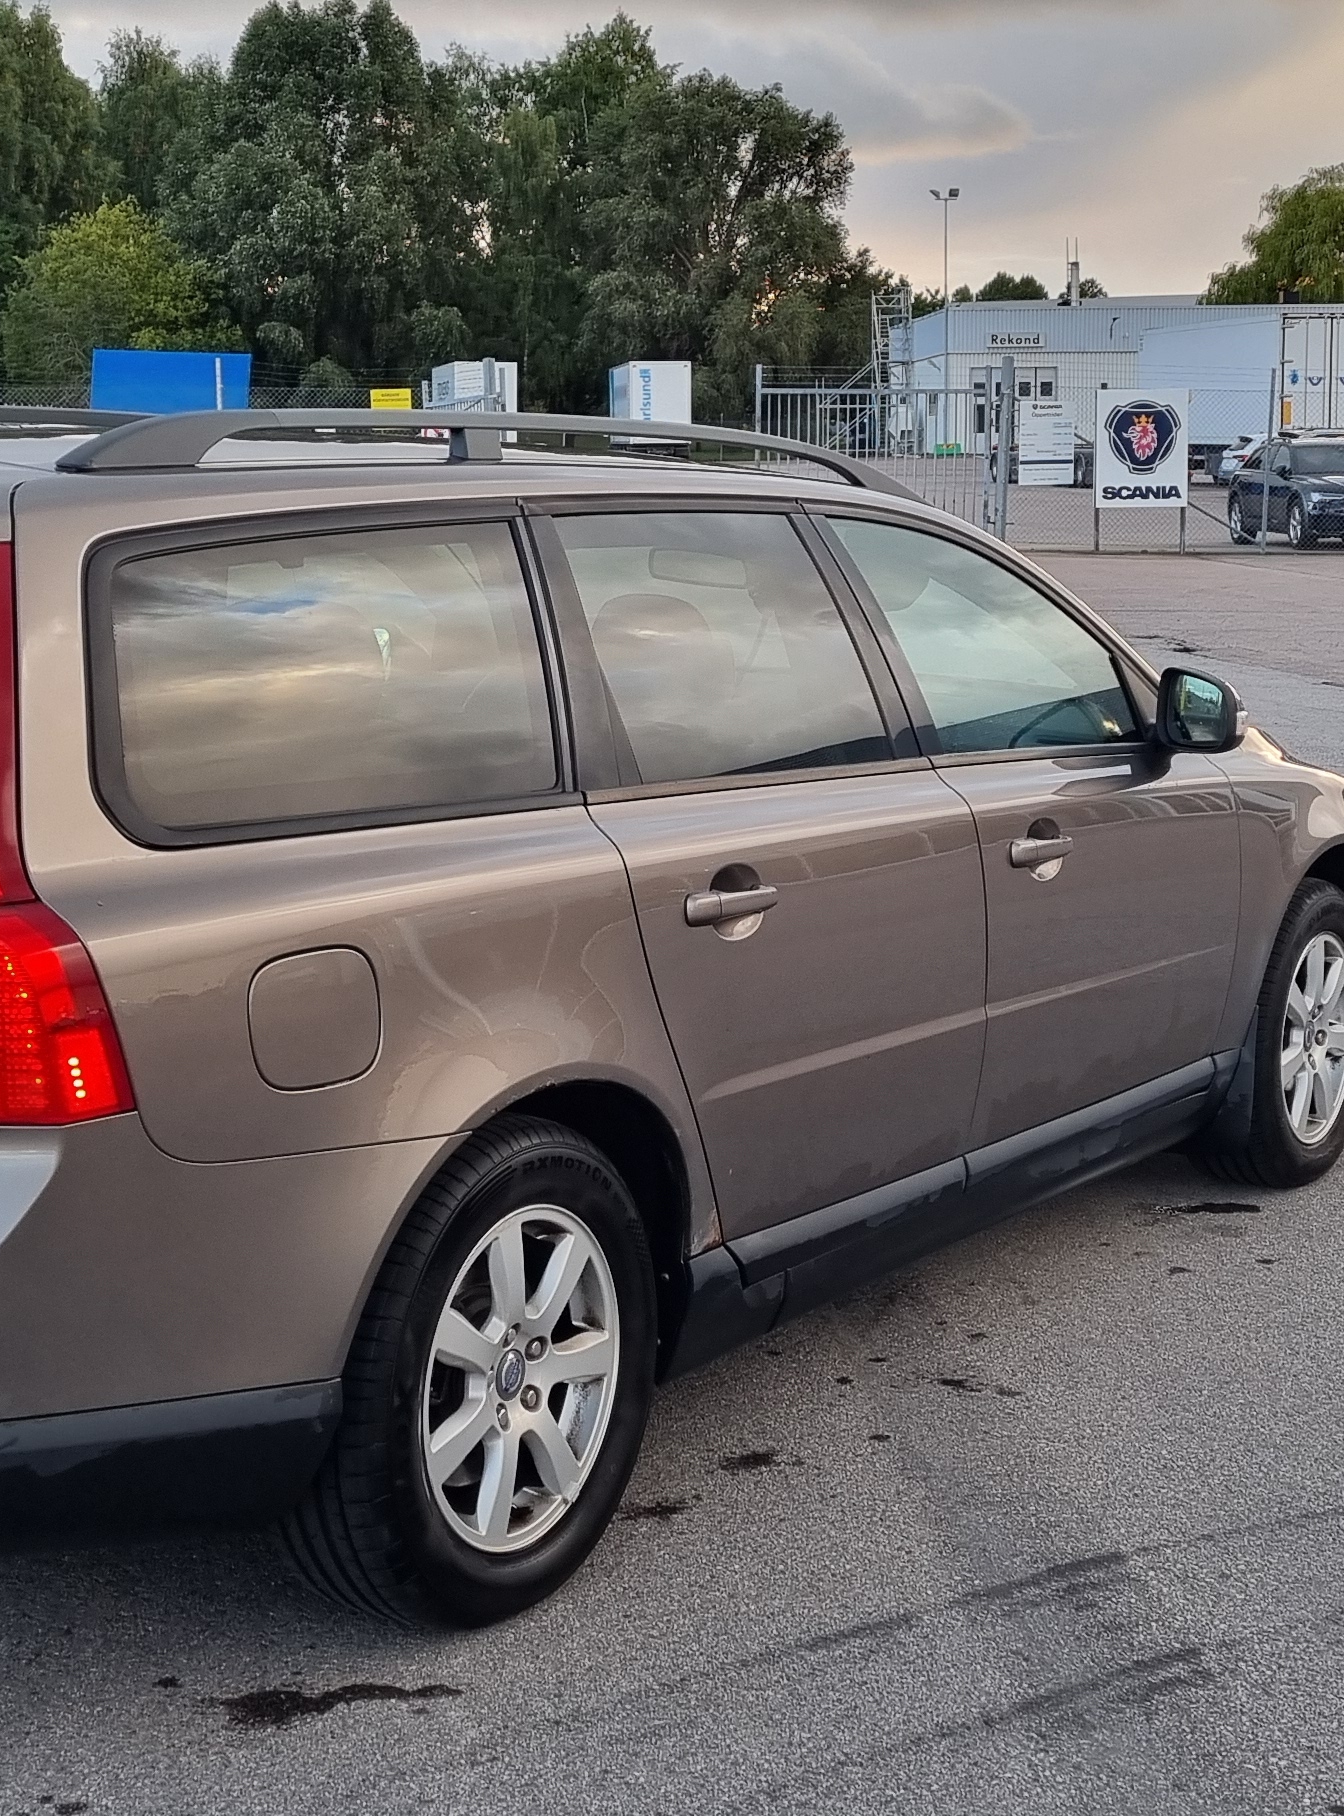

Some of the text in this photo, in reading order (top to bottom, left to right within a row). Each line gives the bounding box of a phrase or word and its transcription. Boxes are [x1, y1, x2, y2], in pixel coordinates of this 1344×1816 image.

[991, 333, 1040, 345] Rekond
[640, 375, 652, 421] rlsund
[1101, 485, 1183, 501] SCANIA
